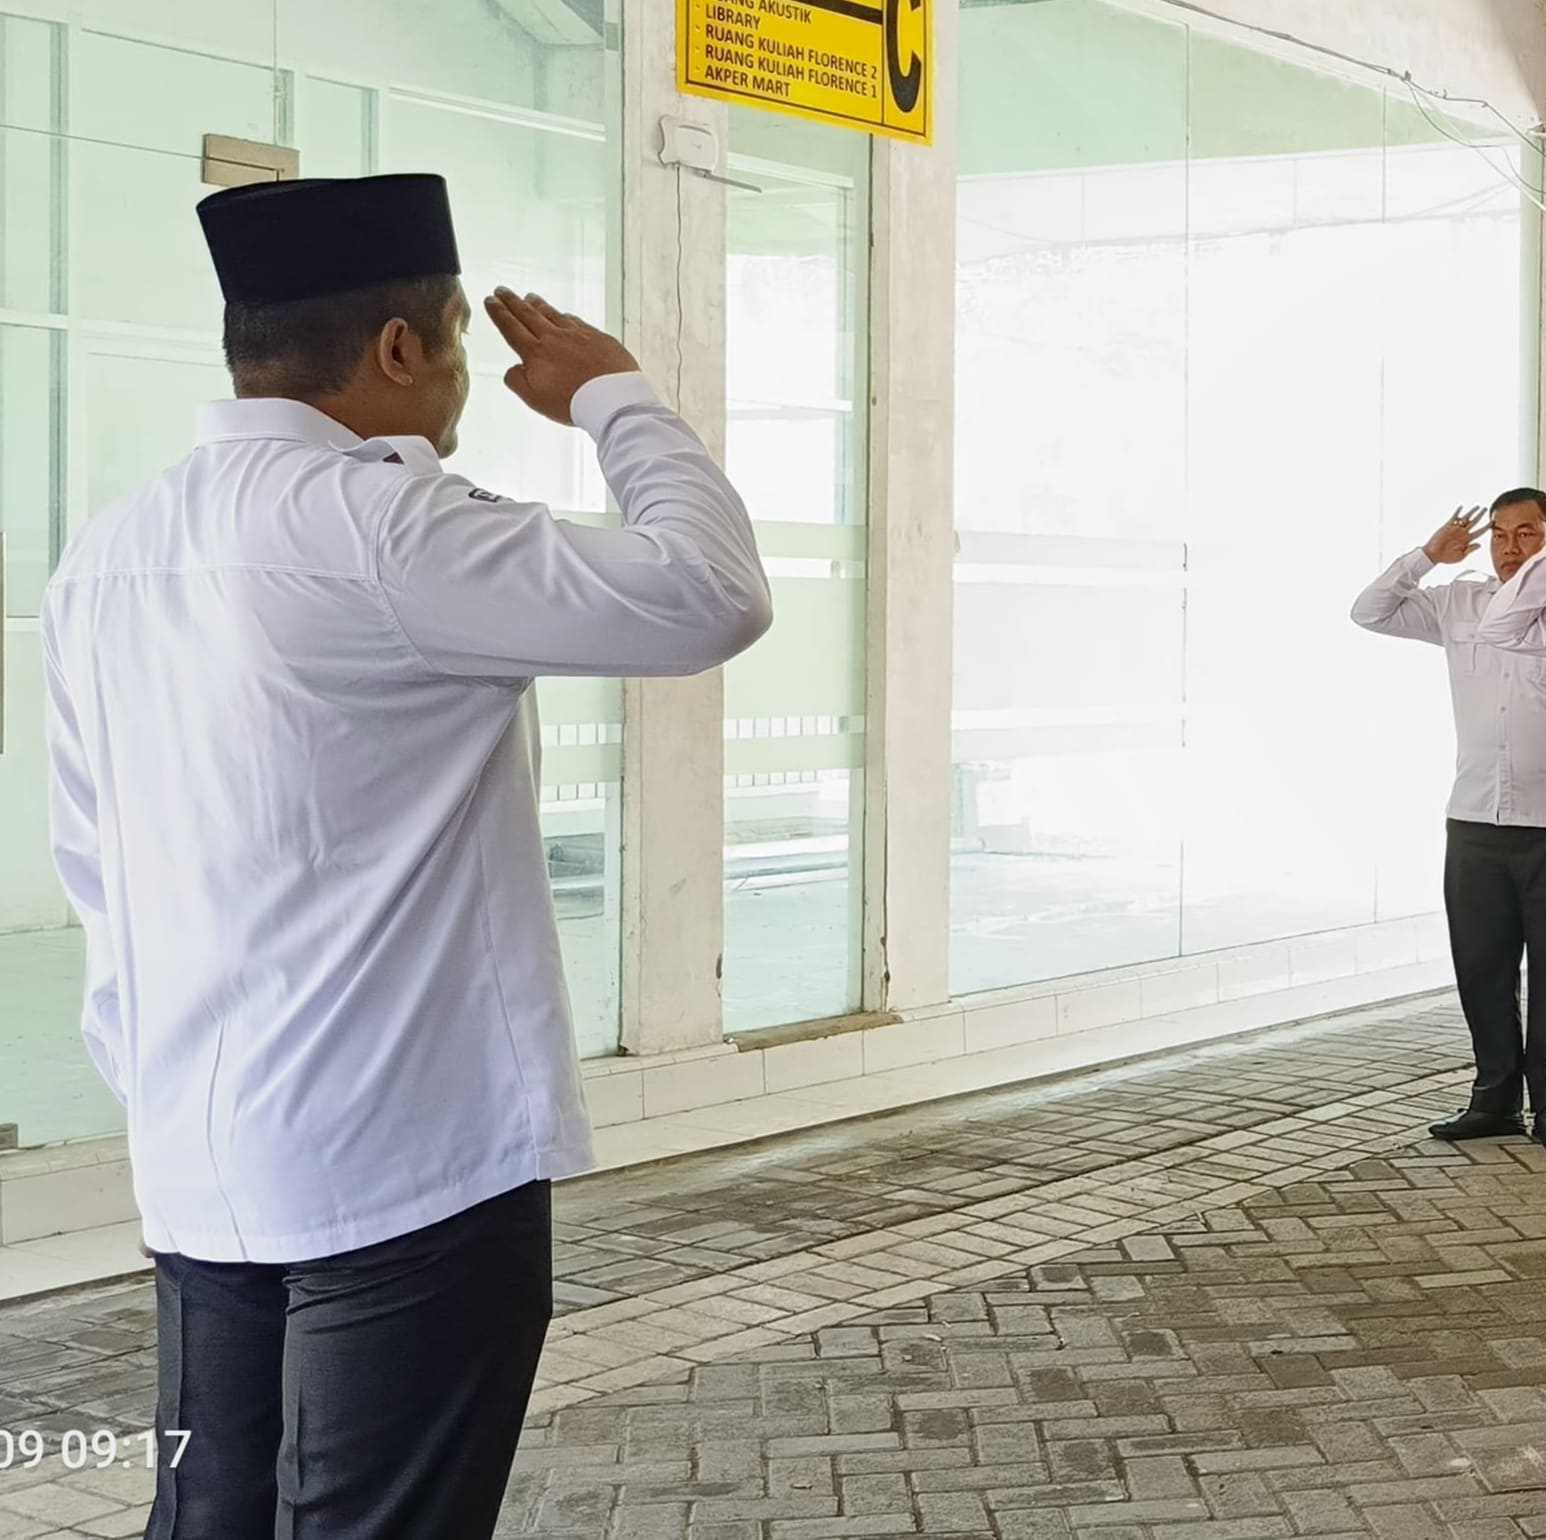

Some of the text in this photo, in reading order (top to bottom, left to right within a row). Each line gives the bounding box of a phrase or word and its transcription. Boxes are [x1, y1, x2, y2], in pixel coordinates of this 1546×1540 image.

[705, 4, 760, 30] LIBRARY
[758, 0, 812, 24] AKUSTIK
[705, 24, 877, 80] RUANG KULIAH FLORENCE 2
[705, 44, 877, 99] RUANG KULIAH FLORENCE 1
[886, 0, 922, 113] C
[704, 65, 791, 97] AKPER MART
